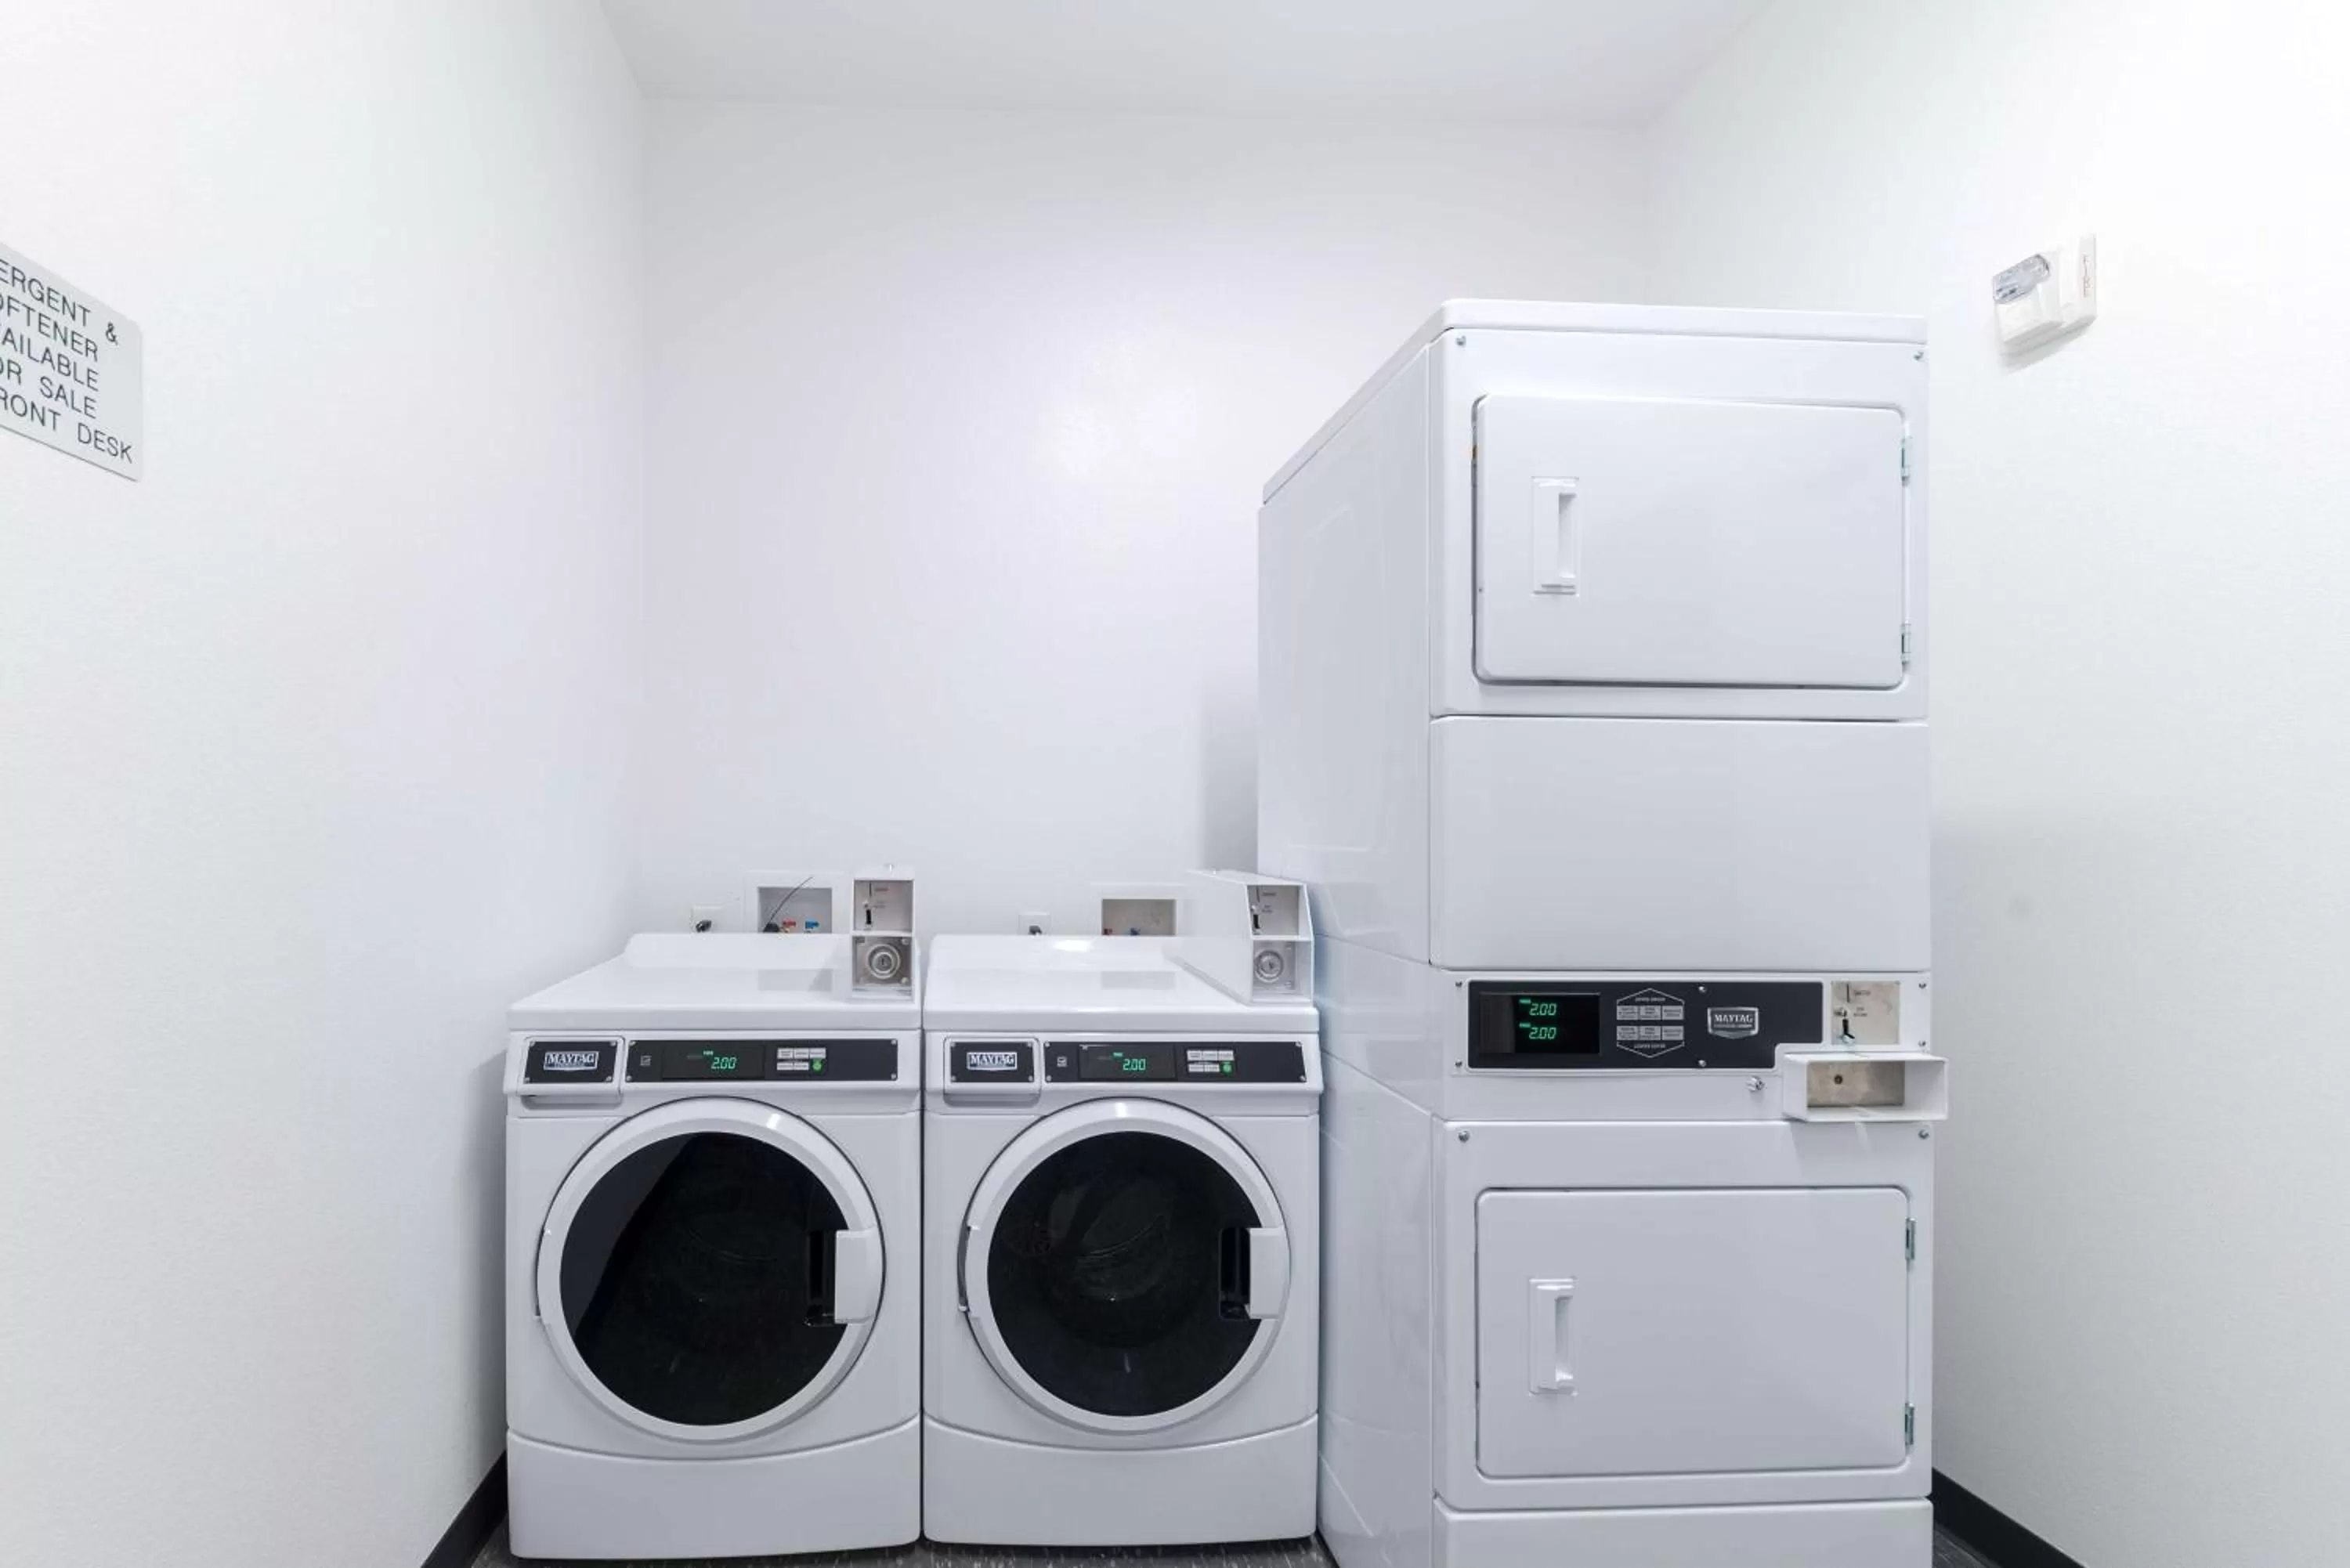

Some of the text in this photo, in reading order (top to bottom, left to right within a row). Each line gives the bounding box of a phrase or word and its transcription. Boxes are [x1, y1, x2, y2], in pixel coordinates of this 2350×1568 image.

[0, 294, 98, 362] FTENER
[106, 321, 119, 345] &
[0, 357, 96, 419] R SALE
[78, 422, 132, 464] DESK
[1529, 1003, 1557, 1016] 2.00
[1714, 1013, 1754, 1023] MAYTAG
[1529, 1027, 1556, 1039] 2.00
[547, 1053, 595, 1064] MAYTAG
[711, 1057, 737, 1069] 2.00
[970, 1054, 1016, 1066] MAYTAG
